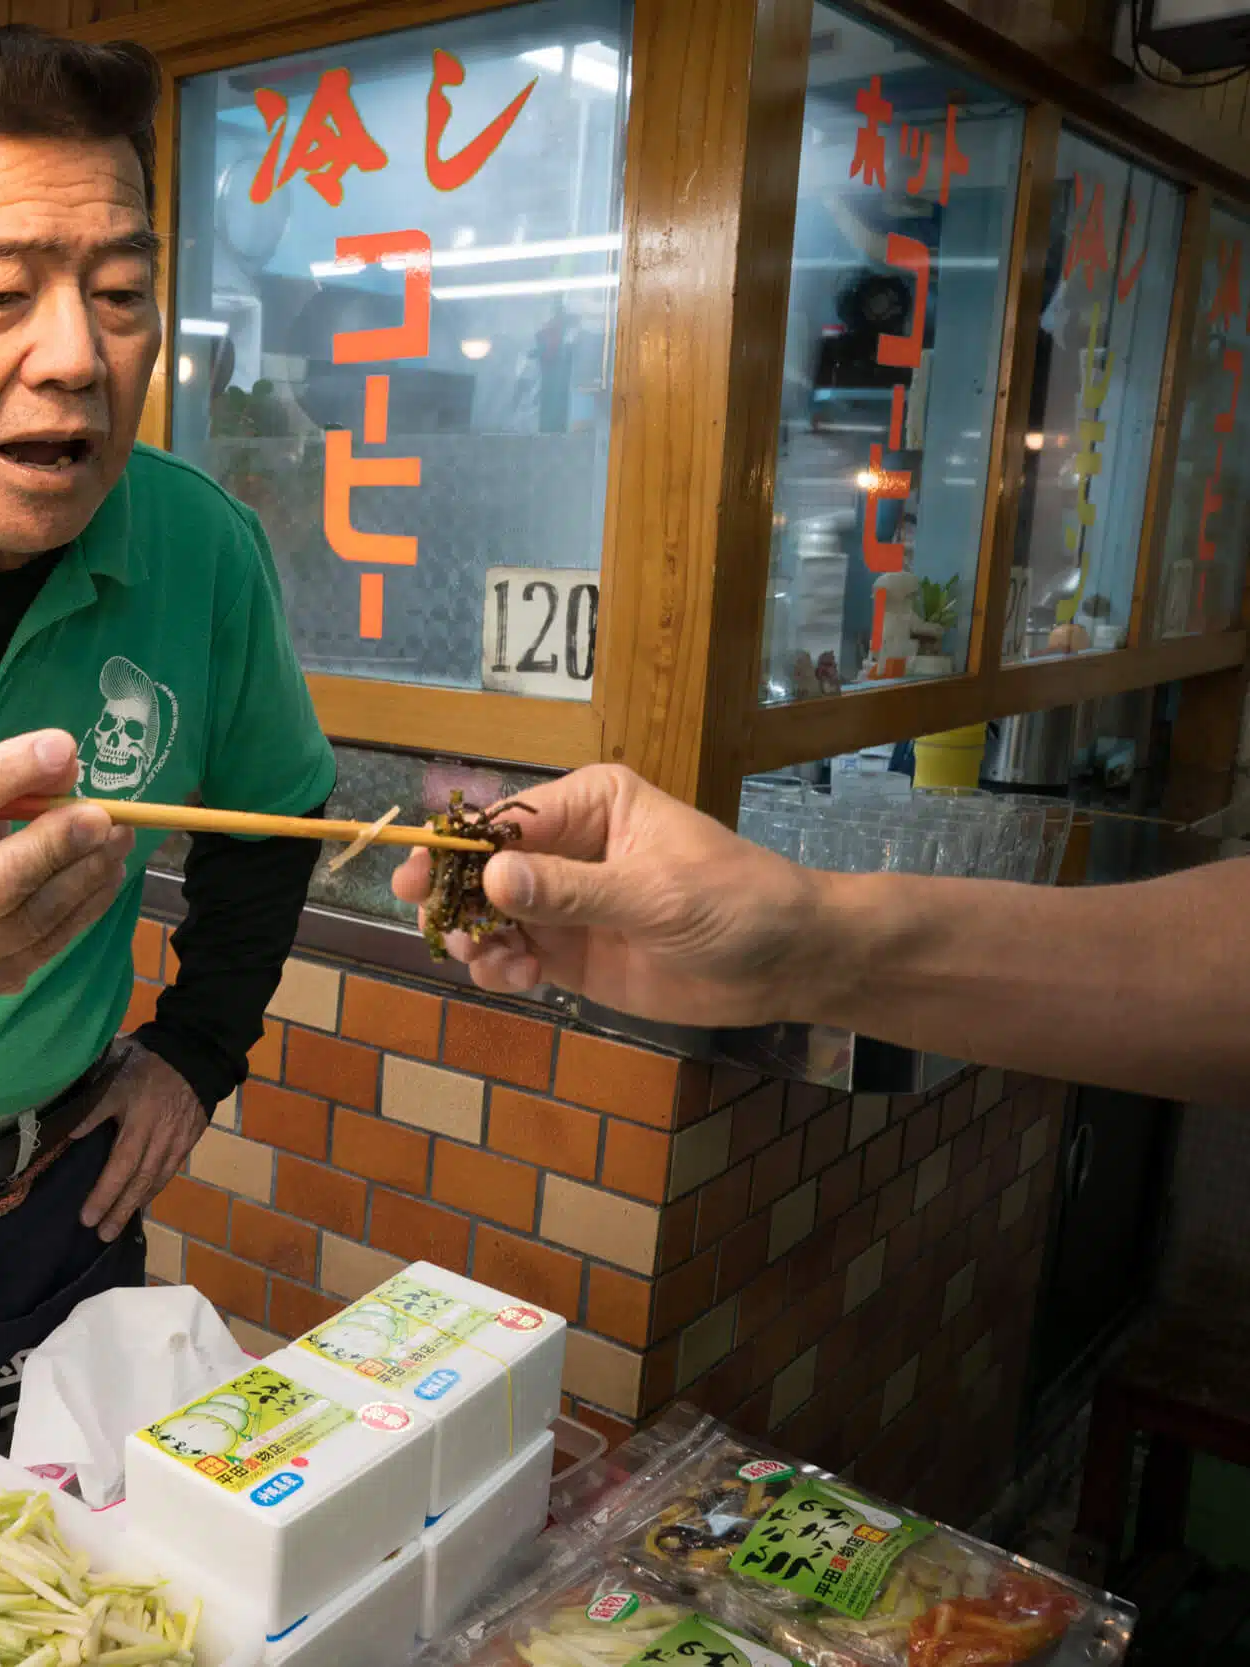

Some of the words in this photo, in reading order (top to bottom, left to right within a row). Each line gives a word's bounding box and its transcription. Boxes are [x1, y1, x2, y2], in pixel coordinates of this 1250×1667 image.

[250, 49, 539, 207] 冷し
[851, 75, 969, 207] ホット
[1063, 171, 1148, 304] 冷し
[1206, 238, 1250, 335] 冷
[324, 229, 432, 639] コーヒー
[863, 231, 929, 652] コーヒー
[490, 580, 599, 681] 120
[215, 1443, 287, 1487] 平田漬物店
[813, 1534, 866, 1598] 平田漬物店
